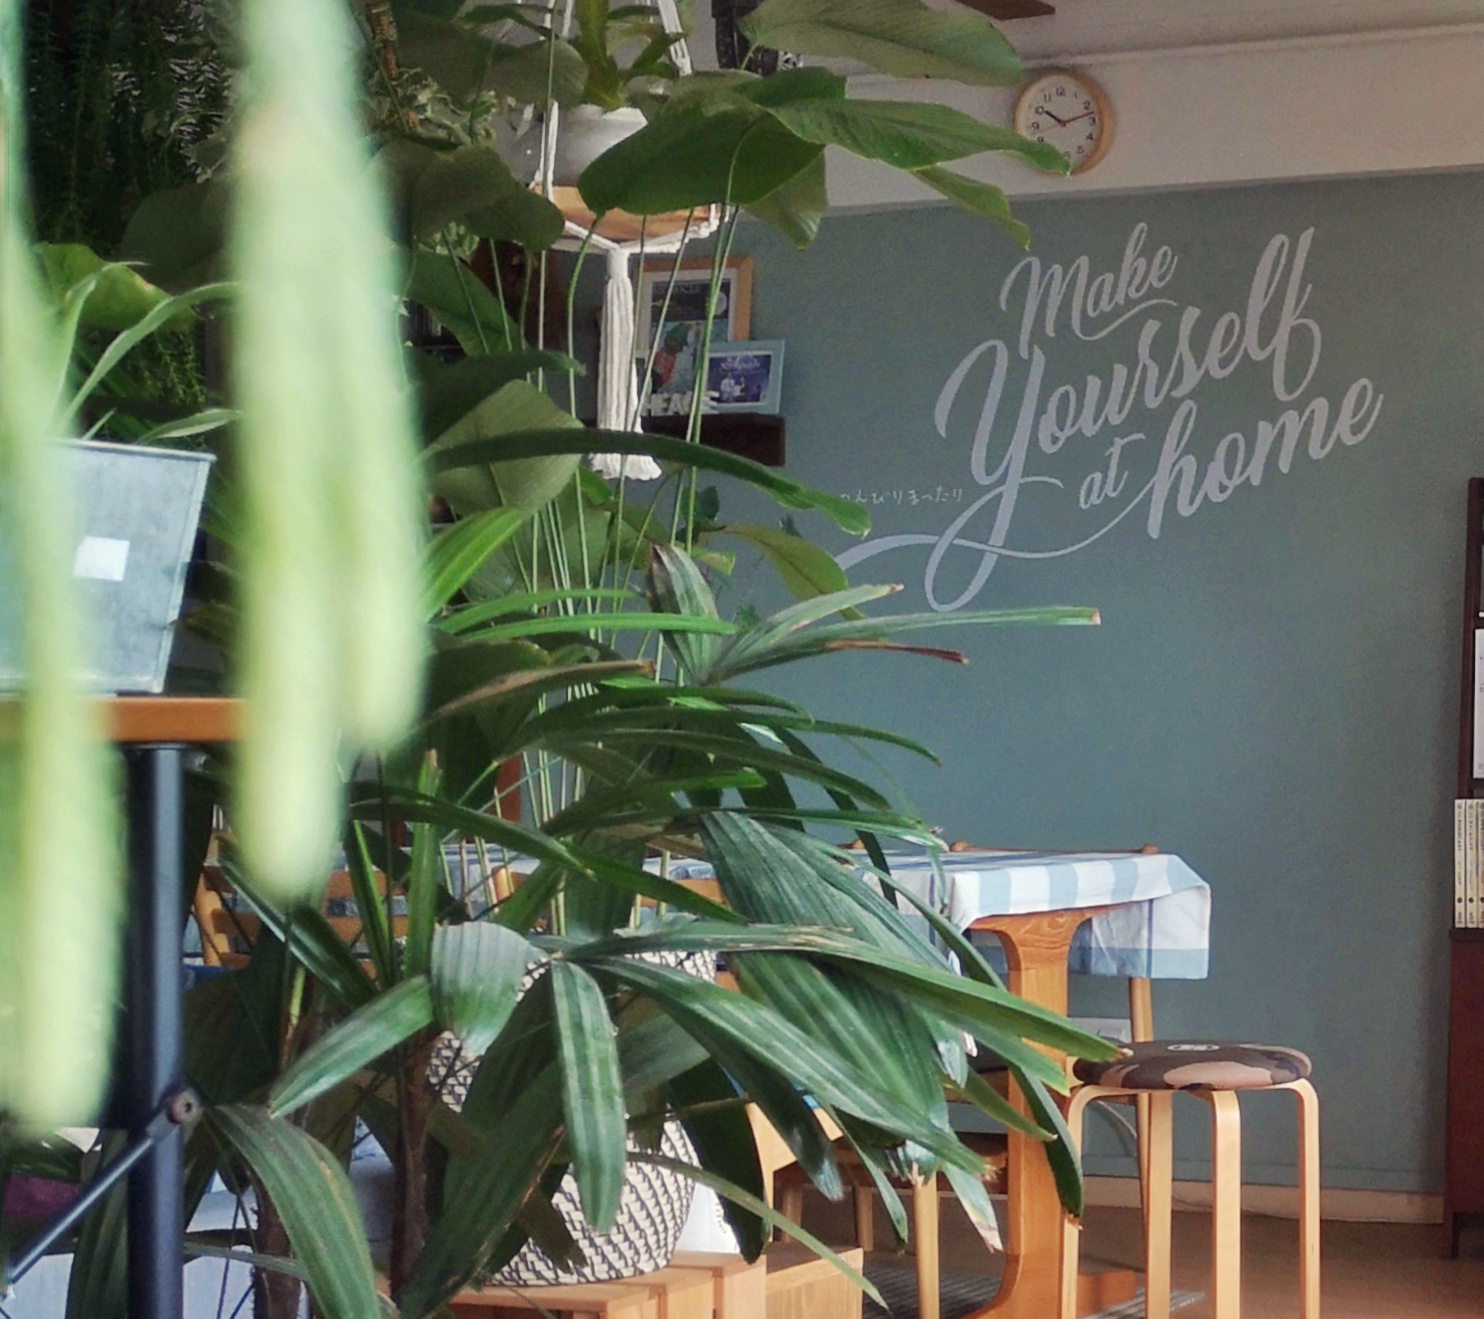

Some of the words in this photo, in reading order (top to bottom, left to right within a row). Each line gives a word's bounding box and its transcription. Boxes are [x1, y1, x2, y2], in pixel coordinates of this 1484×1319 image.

[1056, 87, 1065, 96] 12
[1035, 105, 1044, 115] 10
[1083, 101, 1090, 110] 2
[1089, 116, 1096, 126] 3
[1032, 122, 1039, 130] 9
[1086, 133, 1093, 141] 4
[1077, 145, 1084, 154] 5
[1000, 222, 1178, 359] Make
[925, 227, 1321, 612] Yourself
[1079, 433, 1146, 509] at
[1147, 378, 1384, 539] home
